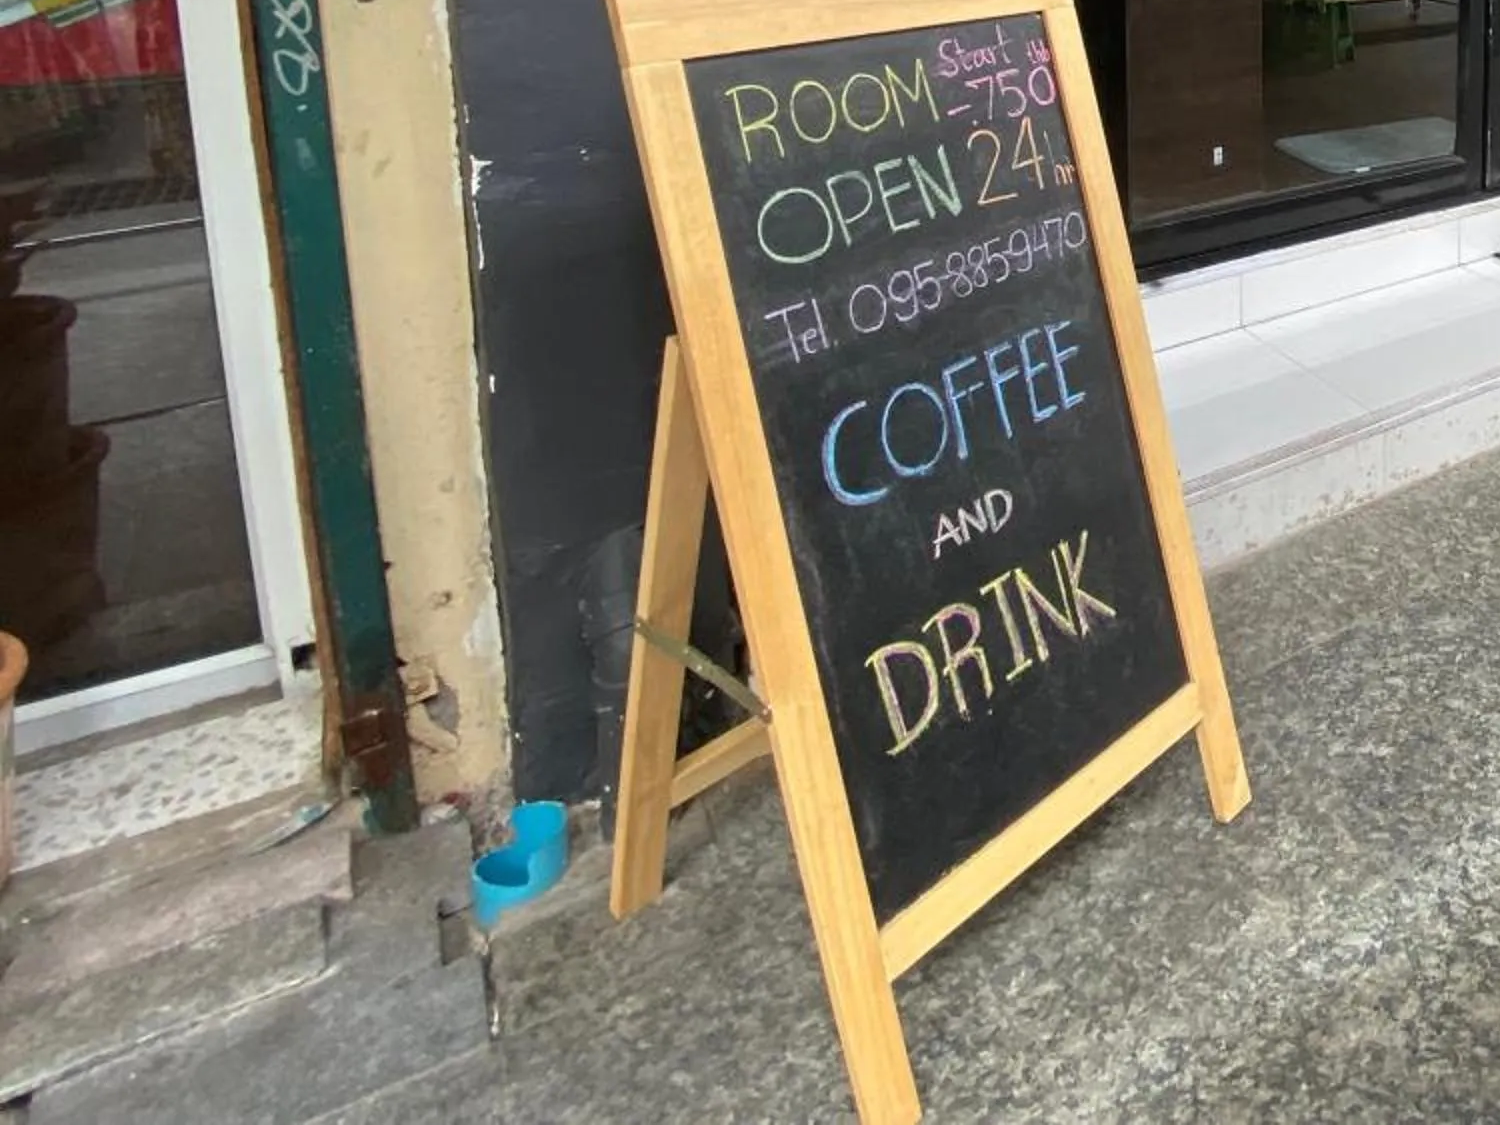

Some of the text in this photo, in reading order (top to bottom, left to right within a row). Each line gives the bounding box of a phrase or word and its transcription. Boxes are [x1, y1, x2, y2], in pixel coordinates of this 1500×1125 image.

[724, 58, 940, 163] ROOM
[938, 23, 1013, 78] Start
[757, 144, 963, 264] OPEN
[967, 117, 1045, 207] 24
[820, 320, 1088, 506] COFFEE
[931, 488, 1014, 560] AND
[863, 528, 1118, 757] DRINK
